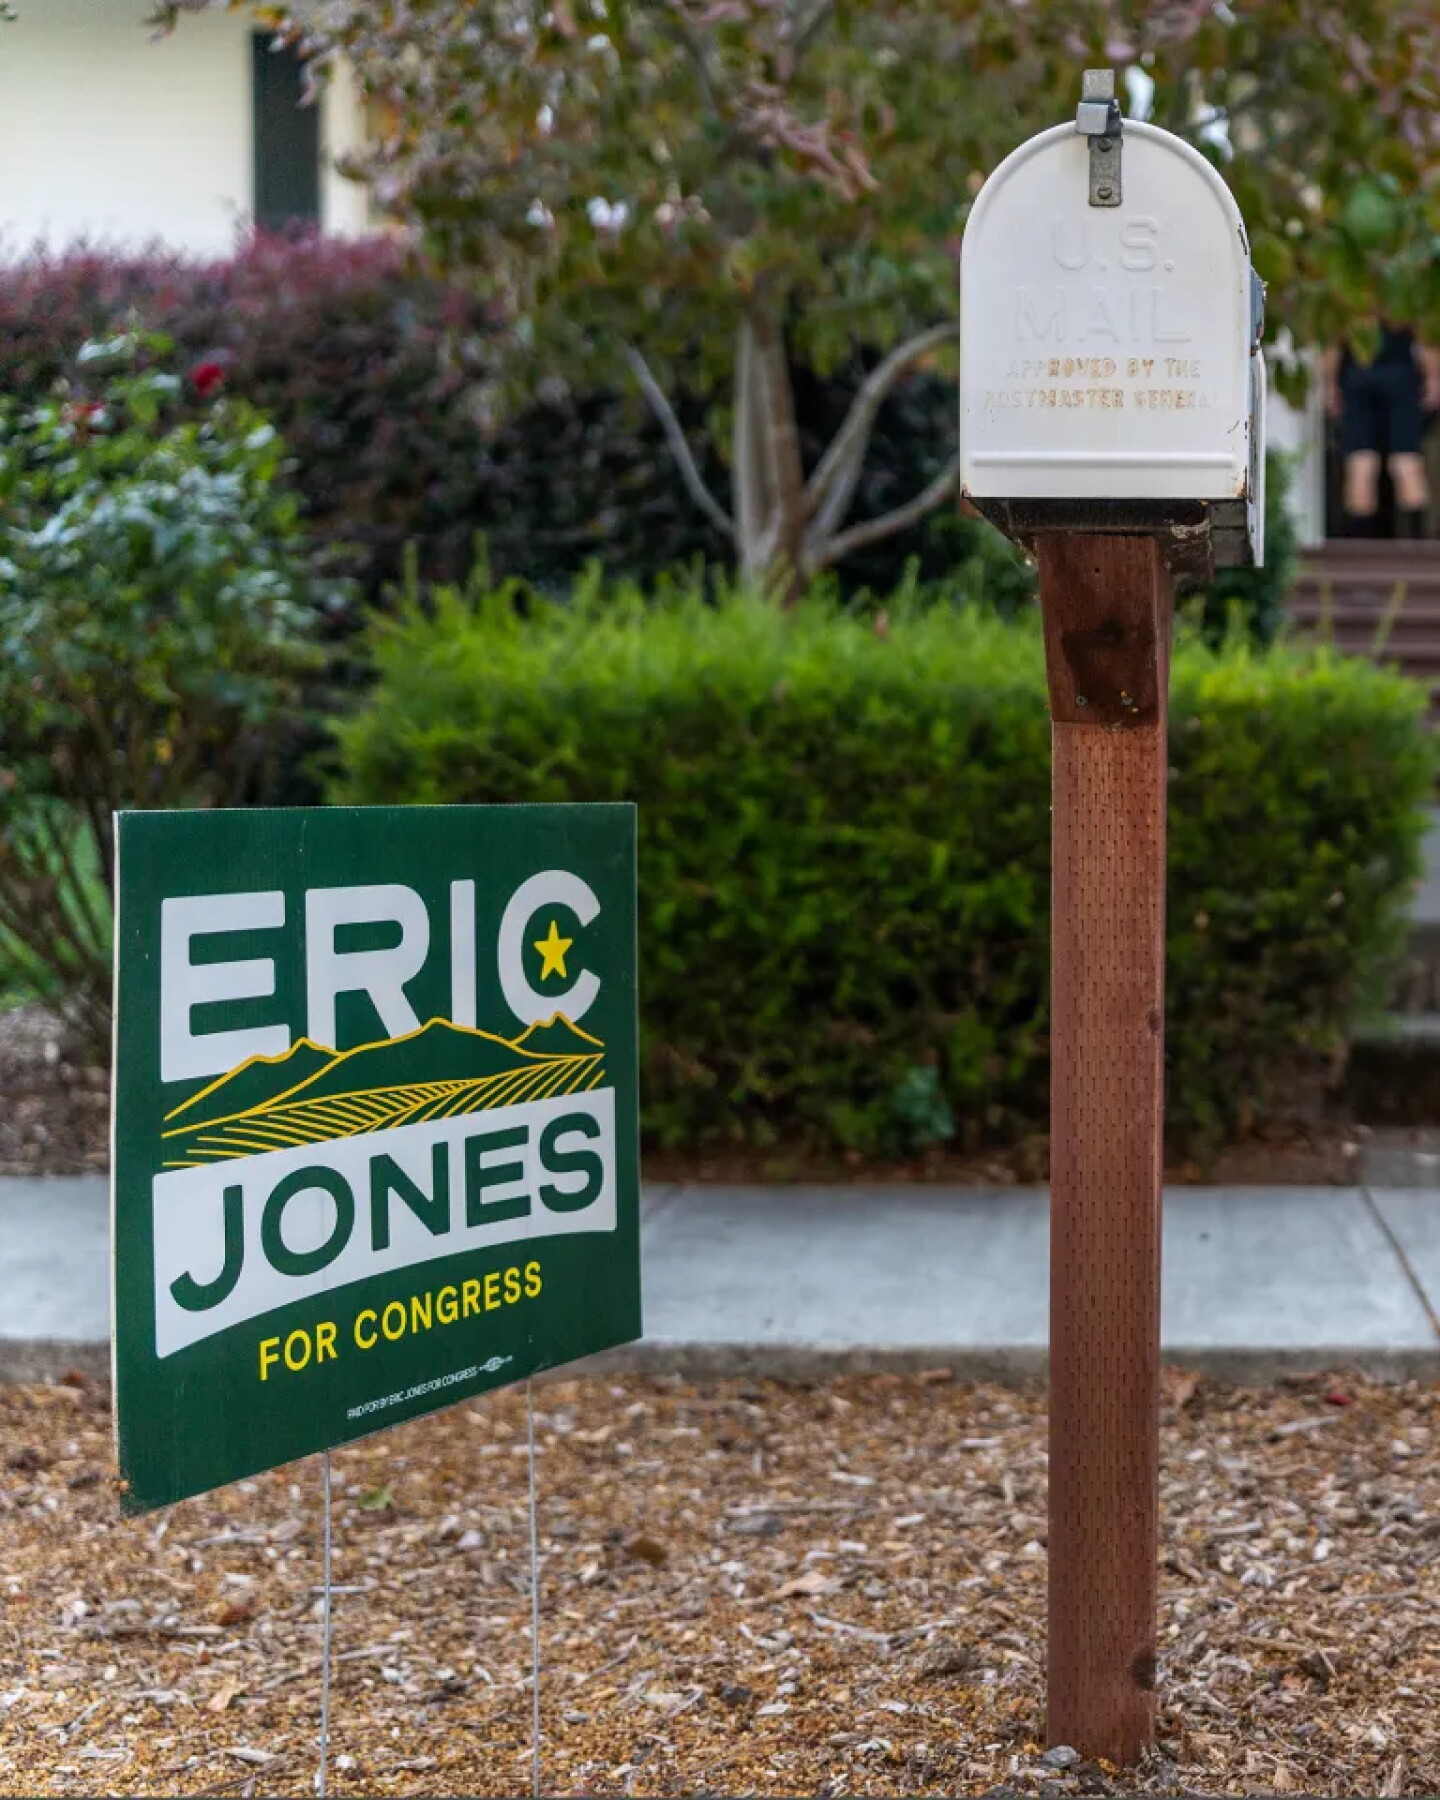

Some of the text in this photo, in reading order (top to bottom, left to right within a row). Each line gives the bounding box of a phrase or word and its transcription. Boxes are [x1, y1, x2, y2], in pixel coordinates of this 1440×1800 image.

[1049, 212, 1175, 273] U.S.
[1014, 286, 1193, 343] MAIL
[1006, 357, 1201, 379] APPROVED BY THE
[984, 388, 1124, 410] POSTMASTER
[161, 869, 602, 1083] ERIC
[169, 1111, 604, 1313] JONES
[259, 1261, 543, 1381] FOR CONGRESS
[389, 1391, 404, 1406] ERIC
[405, 1384, 427, 1400] JONES
[427, 1377, 442, 1392] FOR
[442, 1366, 478, 1387] CONGRESS
